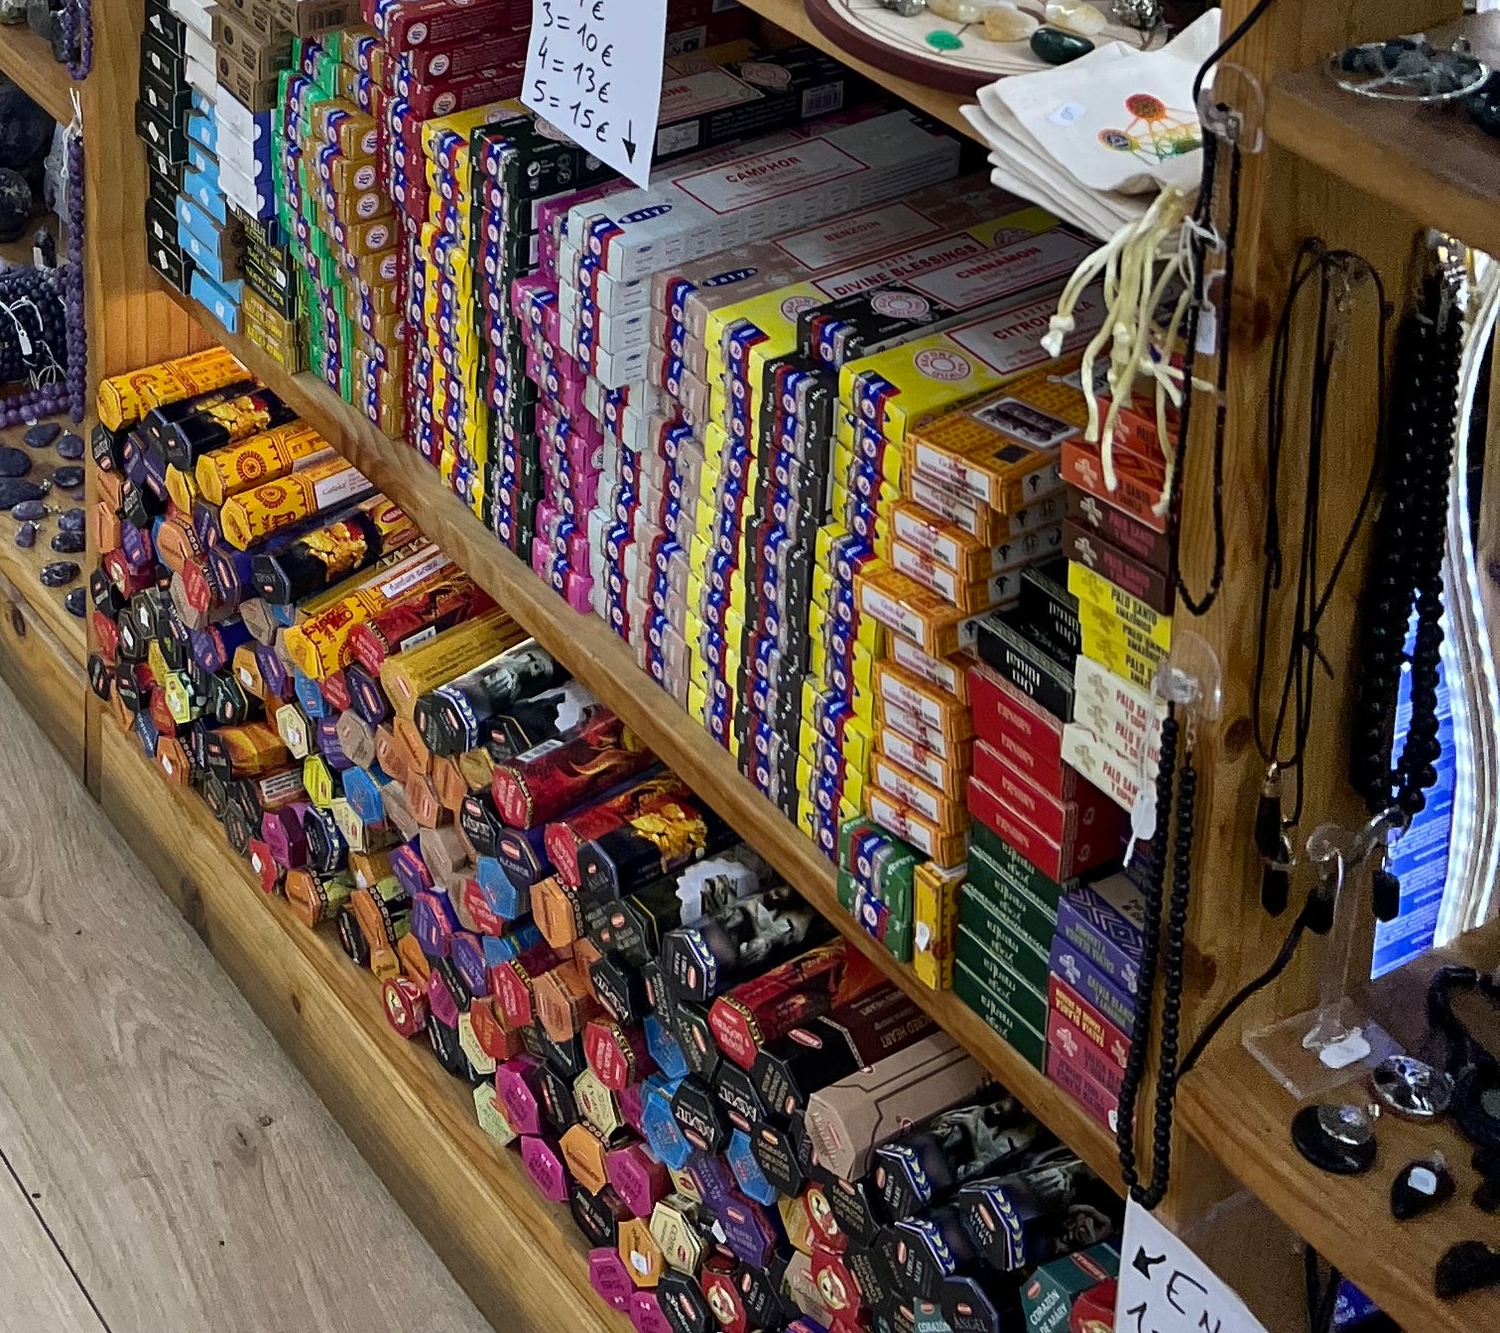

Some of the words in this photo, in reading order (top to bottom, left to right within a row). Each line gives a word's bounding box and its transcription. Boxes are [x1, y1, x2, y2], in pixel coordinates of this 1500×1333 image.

[725, 156, 802, 183] CAMPHOR
[824, 220, 882, 242] BENZOIN
[833, 273, 890, 296] DIVINE
[893, 244, 979, 278] BLESSINGS
[955, 246, 1042, 279] CINNAMON
[1111, 587, 1130, 611] PALO
[1133, 598, 1158, 626] SANTO
[1123, 623, 1142, 645] PALO
[1125, 653, 1144, 677] PALO
[1116, 689, 1134, 712] PALO
[1115, 720, 1134, 745] PALO
[1102, 760, 1121, 784] PALO
[1030, 1289, 1060, 1325] CORAZÓN
